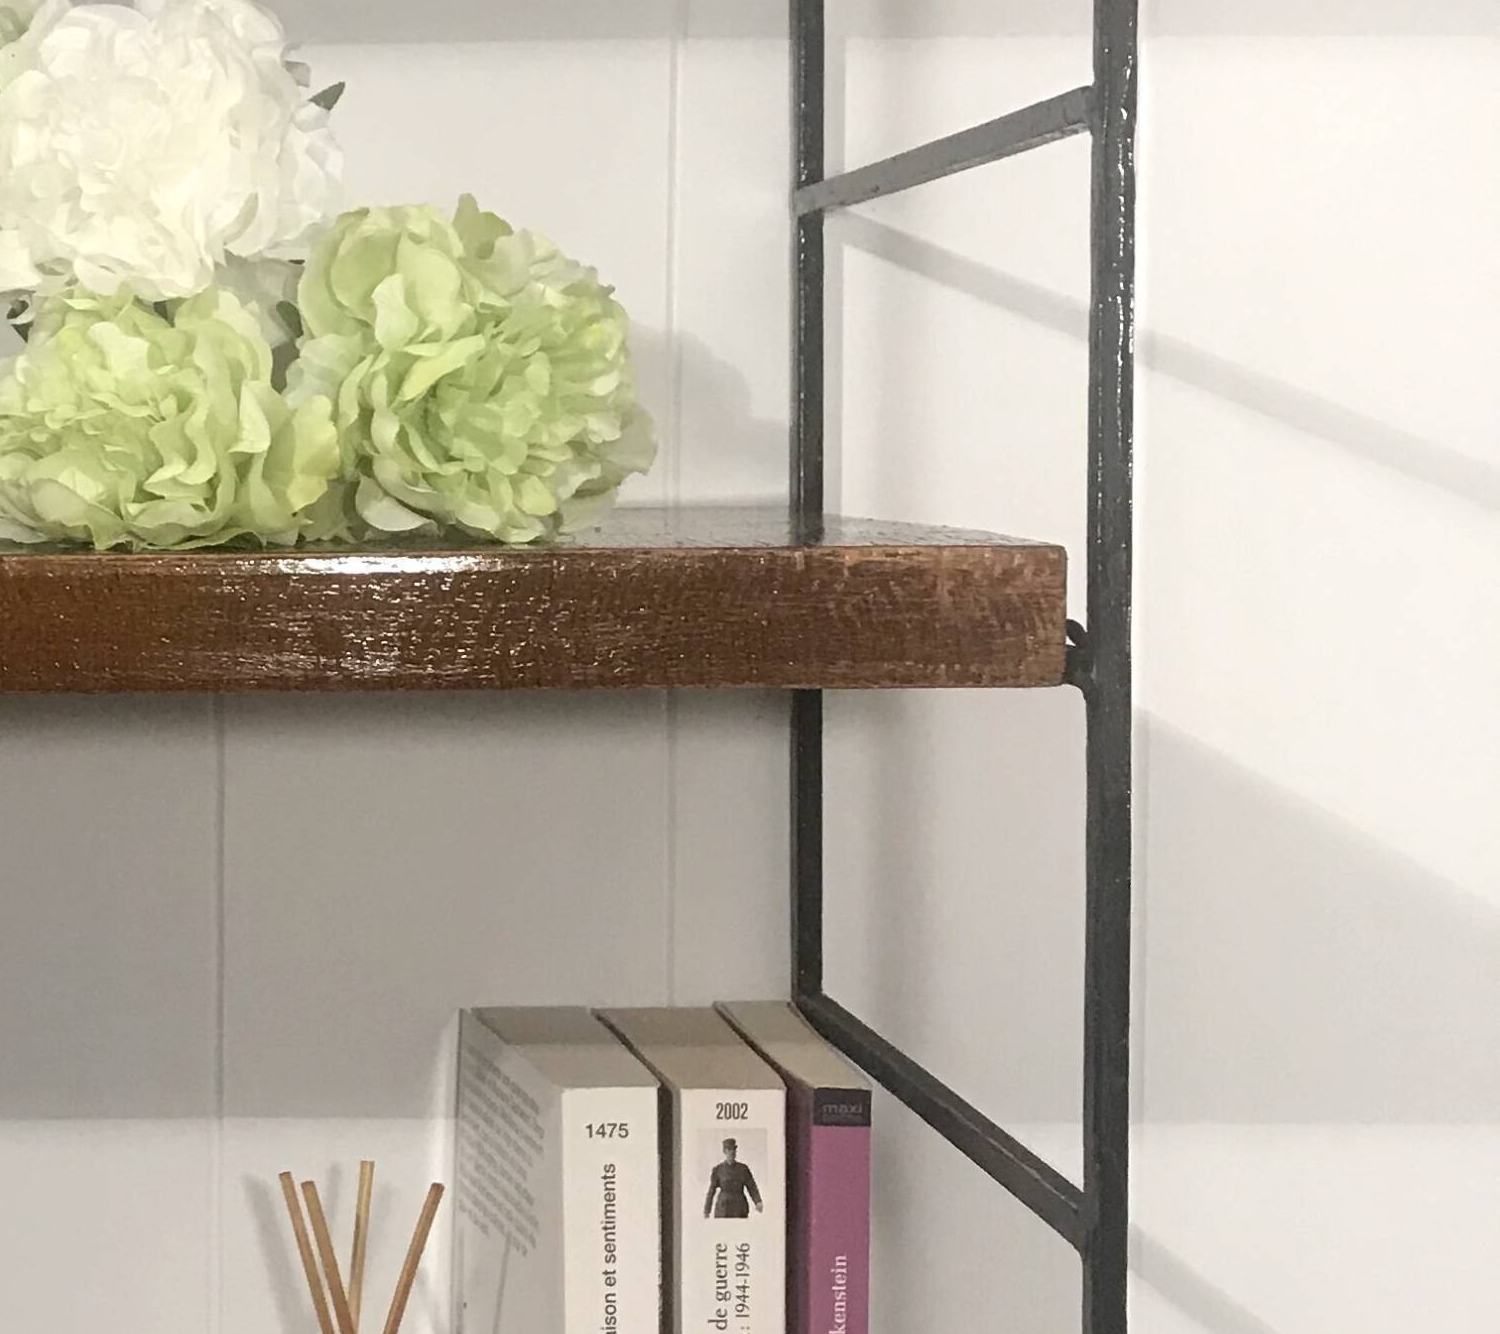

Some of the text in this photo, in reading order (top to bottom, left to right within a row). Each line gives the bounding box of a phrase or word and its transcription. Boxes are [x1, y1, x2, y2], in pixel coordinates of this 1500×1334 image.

[715, 1102, 749, 1121] 2002
[585, 1122, 629, 1139] 1475
[601, 1162, 618, 1264] sentiments
[601, 1269, 618, 1288] et
[713, 1242, 735, 1302] guerre
[734, 1242, 751, 1319] 1944-1946
[707, 1308, 729, 1332] de
